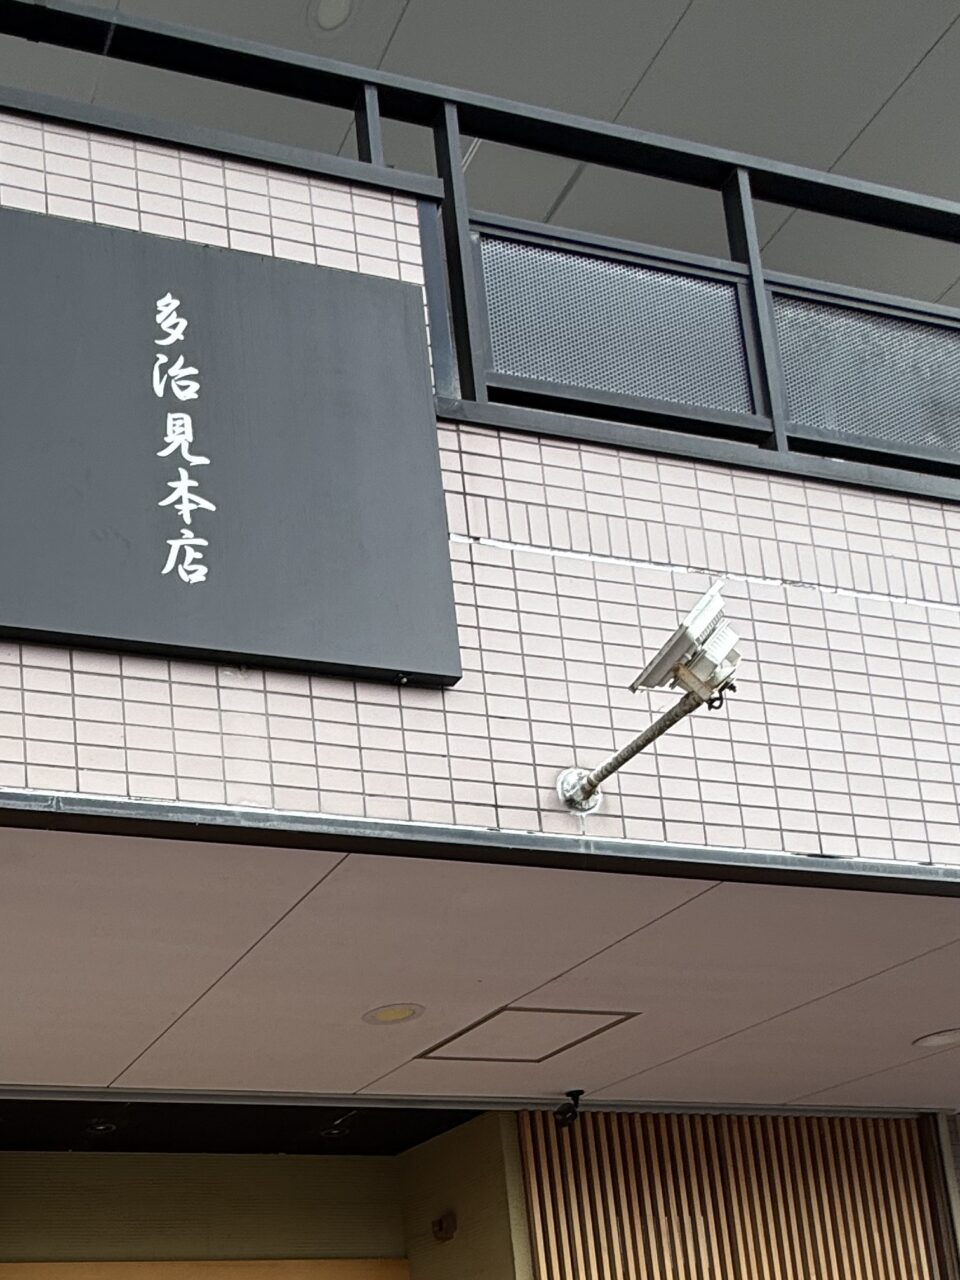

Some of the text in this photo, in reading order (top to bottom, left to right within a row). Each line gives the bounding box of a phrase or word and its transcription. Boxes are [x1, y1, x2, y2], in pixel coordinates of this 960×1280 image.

[152, 291, 217, 585] 多治見本店
